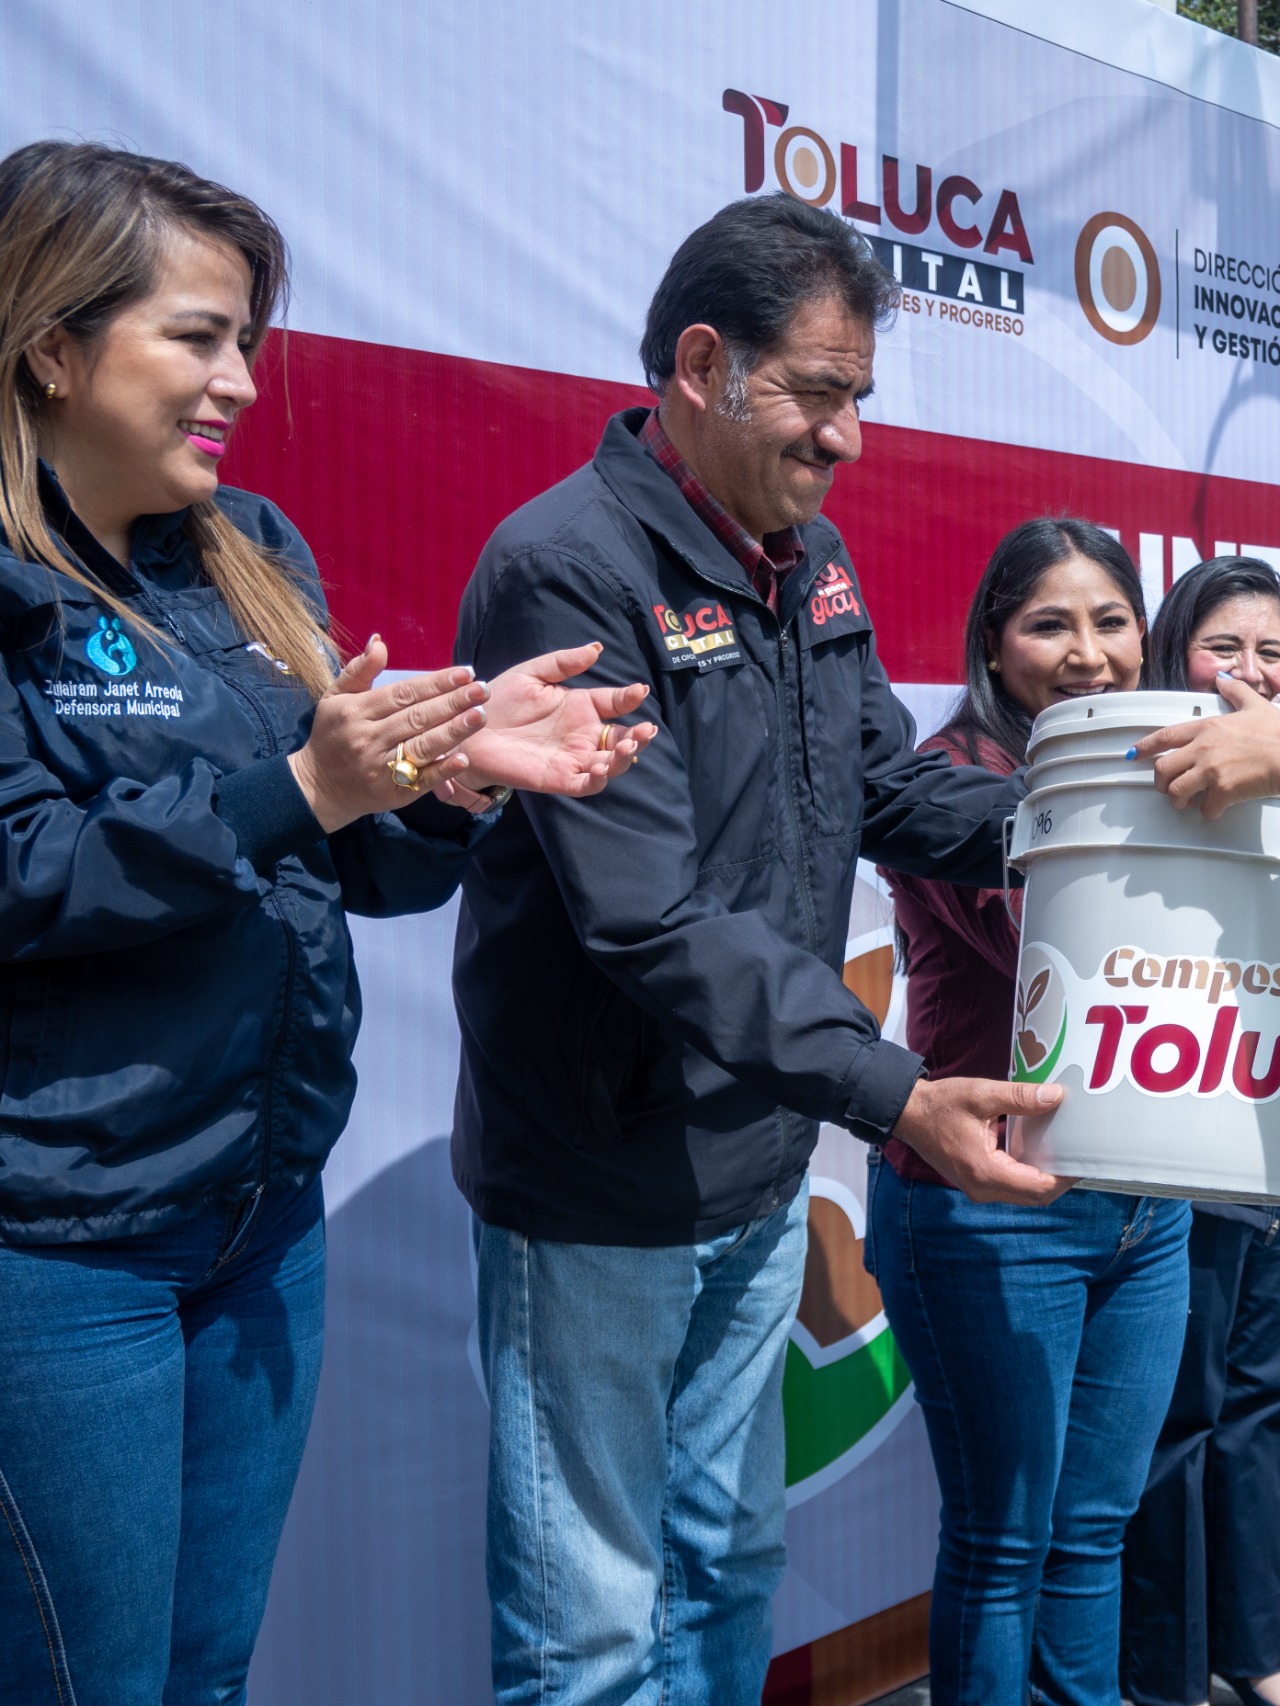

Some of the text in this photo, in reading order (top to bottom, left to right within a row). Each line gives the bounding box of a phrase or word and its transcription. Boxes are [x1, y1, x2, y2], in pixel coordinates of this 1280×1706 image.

[721, 87, 1035, 266] TOLUCA
[925, 298, 935, 317] Y
[939, 301, 1025, 337] PROGRESO
[1193, 323, 1208, 350] Y
[45, 680, 183, 702] Zulairam Janet Arreola
[55, 700, 180, 719] Defensora Municipal
